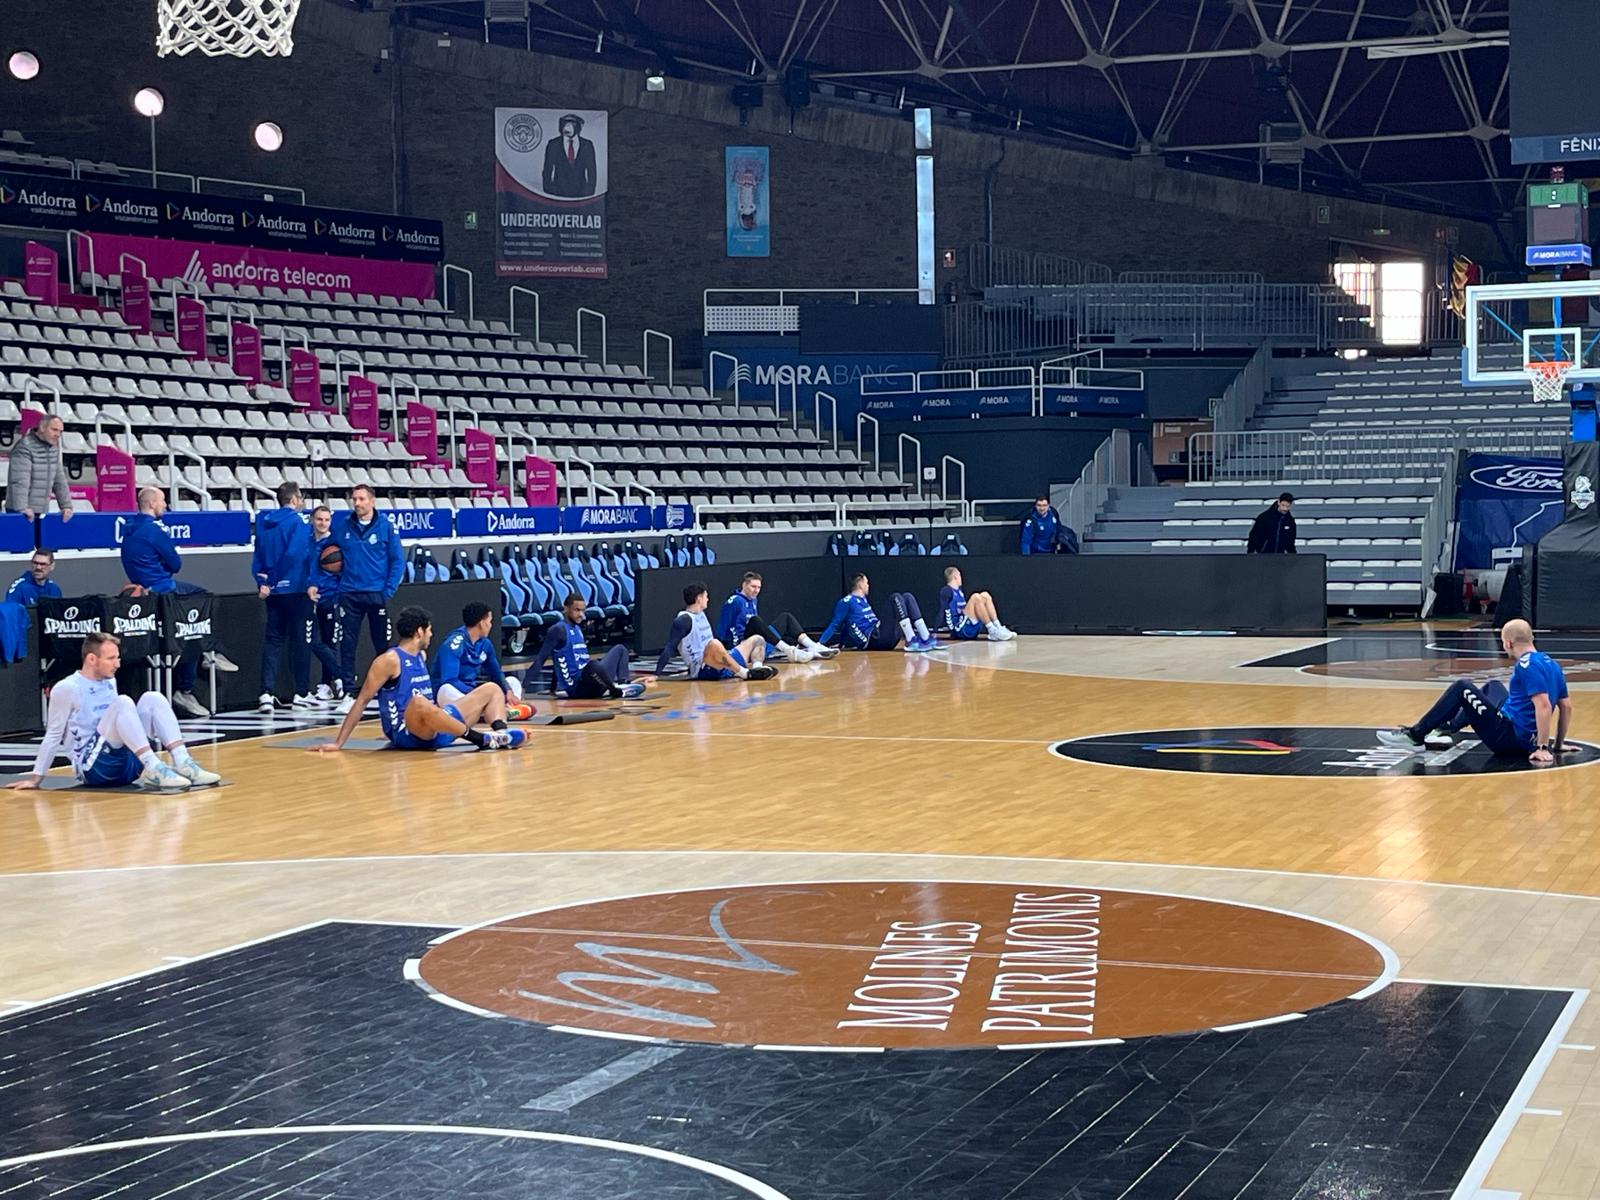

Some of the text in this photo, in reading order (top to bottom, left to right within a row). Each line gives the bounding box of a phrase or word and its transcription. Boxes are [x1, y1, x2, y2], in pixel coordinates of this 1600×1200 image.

[18, 189, 76, 209] Andorra
[102, 198, 158, 217] Andorra
[182, 206, 234, 224] Andorra
[257, 214, 307, 232] Andorra
[501, 213, 601, 228] UNDERCOVERLAB
[328, 222, 375, 239] Andorra
[396, 229, 440, 245] Andorra
[212, 260, 350, 288] andorra telecom
[500, 264, 604, 273] www.undercoverlab.com
[498, 514, 535, 529] Andorra
[590, 508, 639, 524] MORABANC
[44, 617, 101, 634] SPALDING
[114, 614, 156, 634] SPALDING
[981, 893, 1101, 1034] PATRIMONIS
[836, 921, 982, 1031] MOLINES
